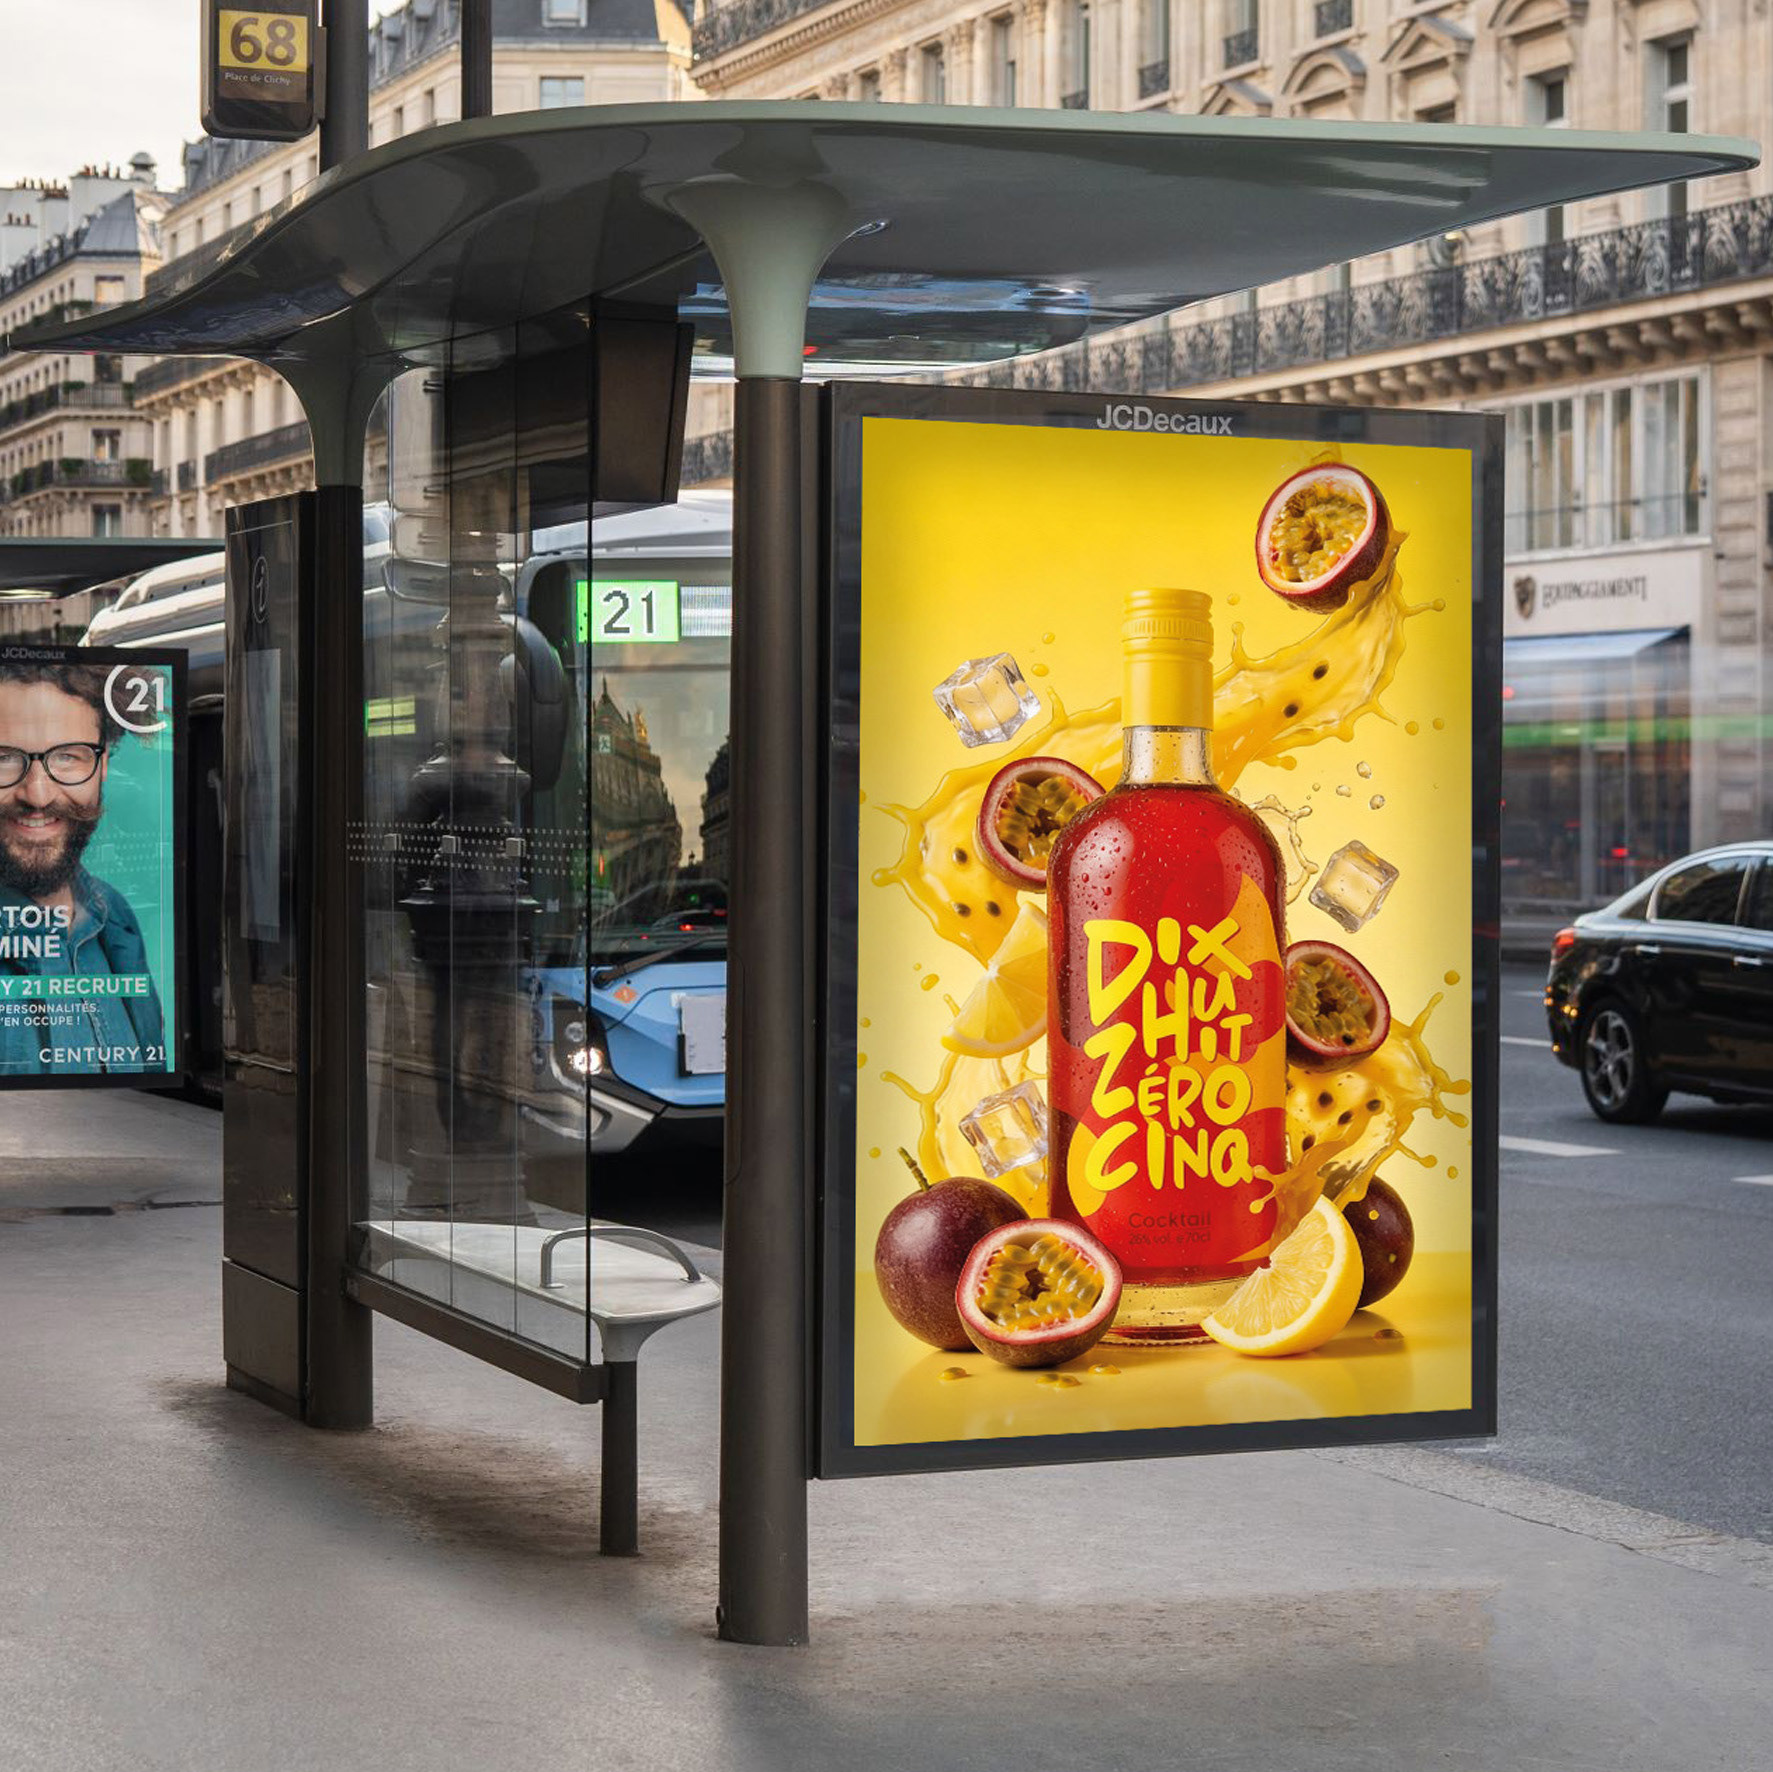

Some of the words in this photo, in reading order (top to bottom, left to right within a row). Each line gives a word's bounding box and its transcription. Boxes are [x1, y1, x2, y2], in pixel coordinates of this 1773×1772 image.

[230, 16, 297, 67] 68
[224, 71, 249, 82] Place
[250, 73, 261, 83] de
[263, 74, 291, 86] Clichy
[1096, 403, 1233, 435] JCDecaux
[603, 590, 654, 634] 21
[1, 646, 66, 660] JCDecaux
[0, 904, 70, 929] TOIS
[1083, 916, 1253, 1027] DIX
[22, 978, 42, 996] 21
[49, 976, 148, 995] RECRUTE
[23, 1015, 74, 1027] OCCUPE
[1142, 966, 1254, 1063] HUIT
[39, 1046, 140, 1064] CENTURY
[145, 1045, 165, 1062] 21
[1083, 1021, 1252, 1131] ZÉRO
[1084, 1120, 1254, 1192] CINQ
[1128, 1207, 1212, 1229] Cocktail
